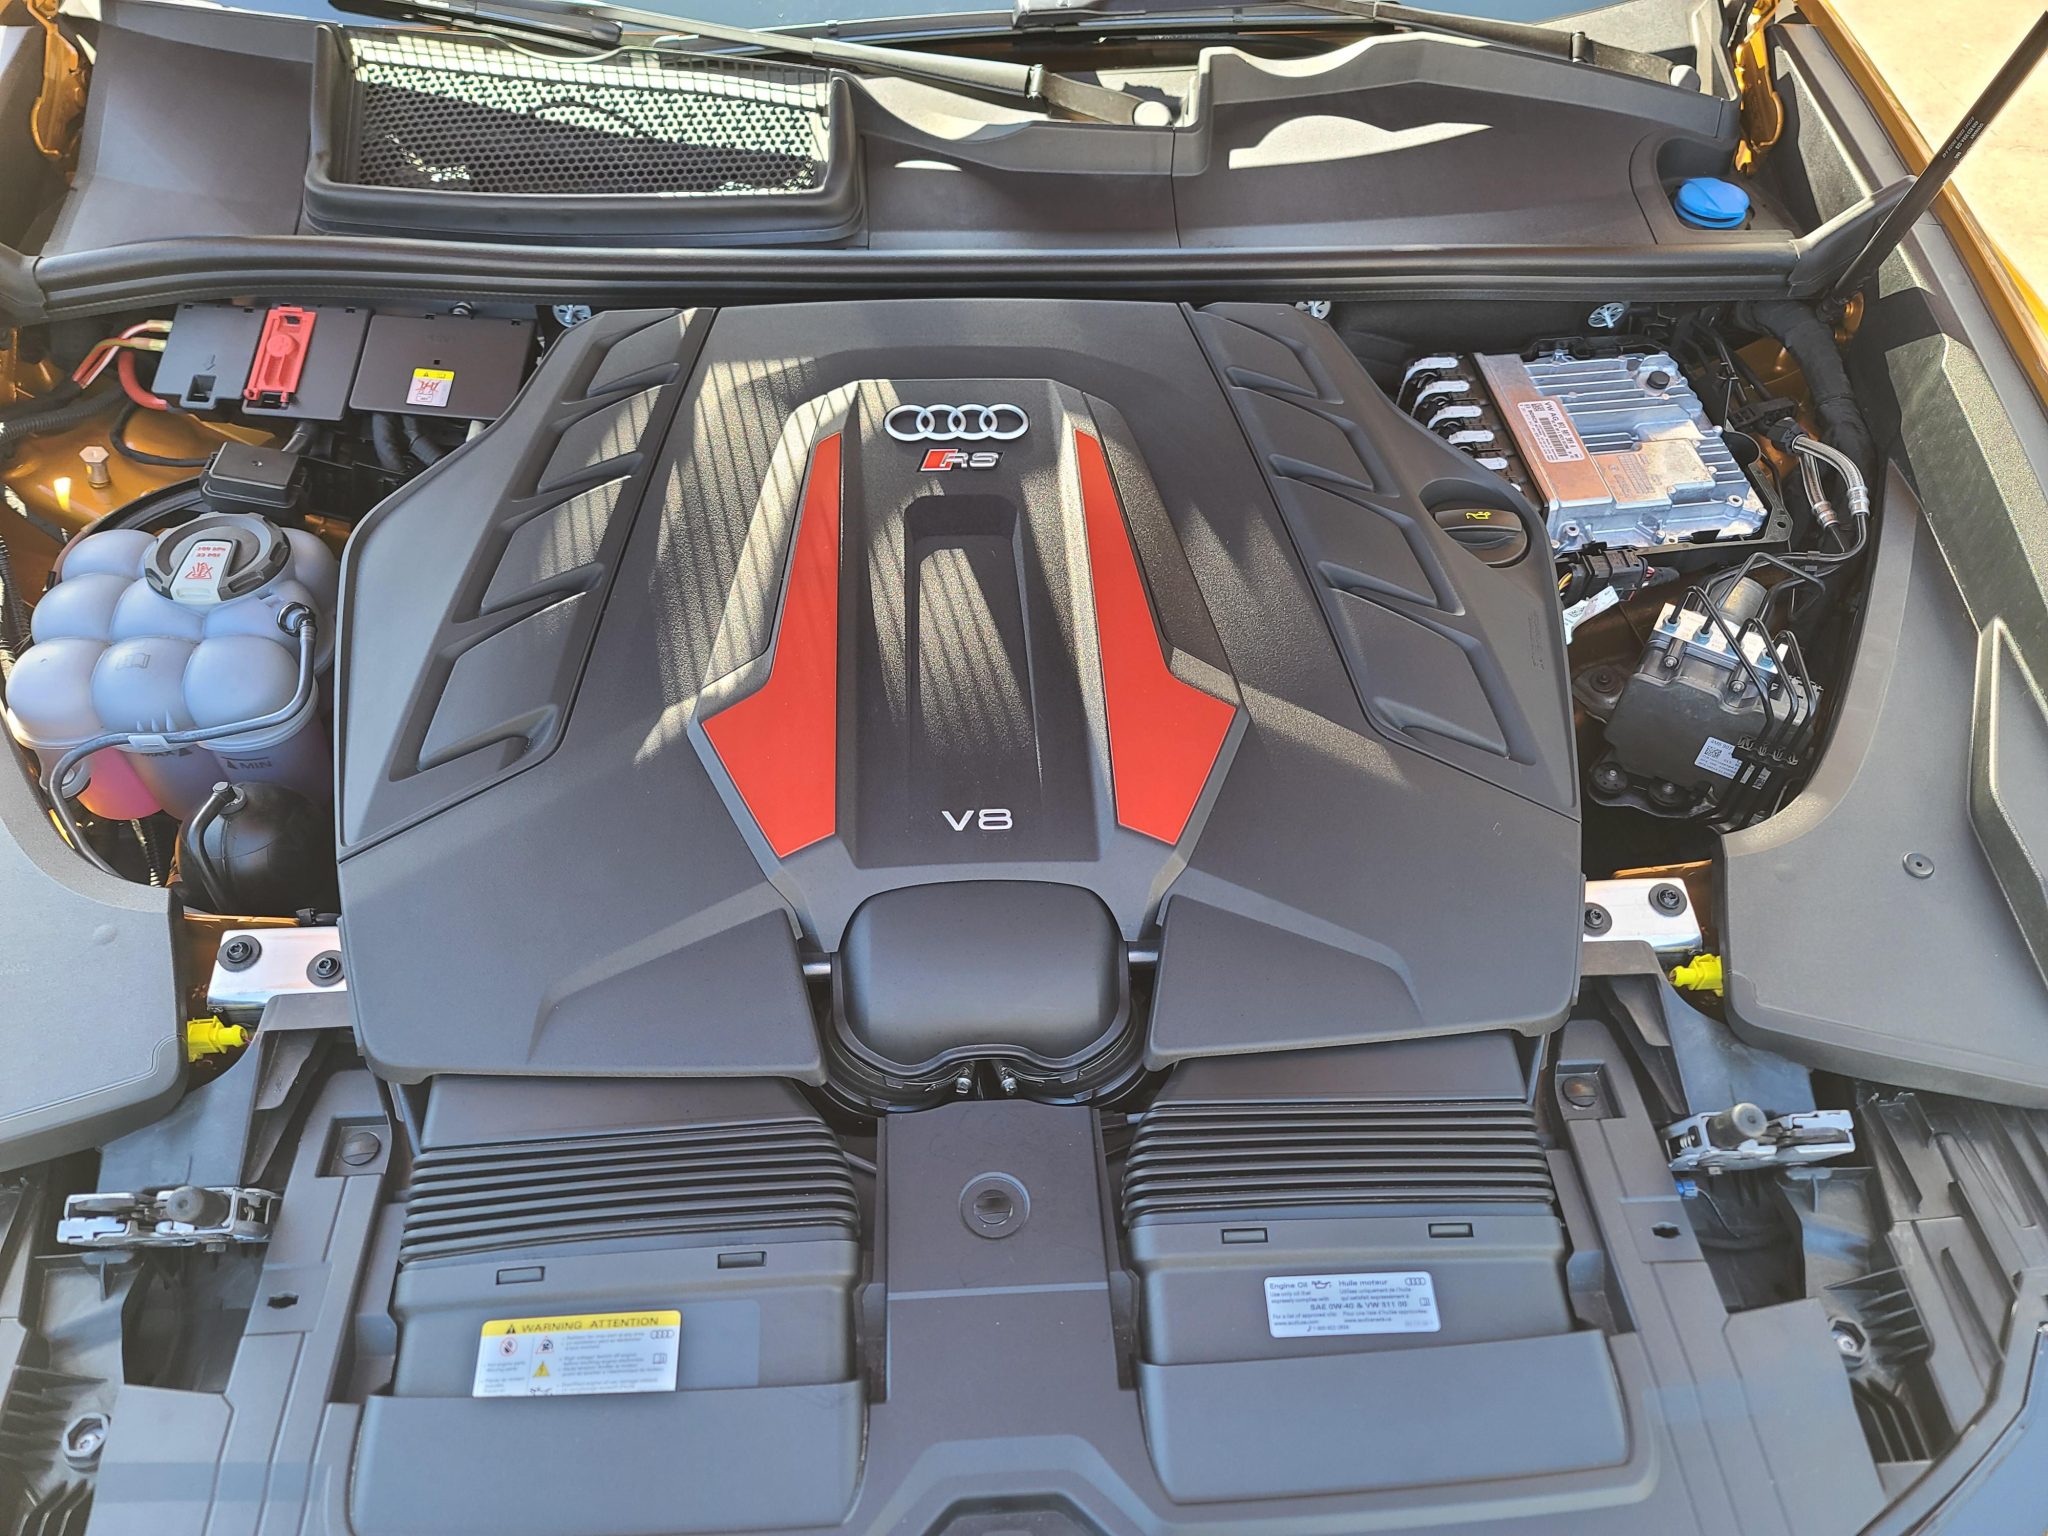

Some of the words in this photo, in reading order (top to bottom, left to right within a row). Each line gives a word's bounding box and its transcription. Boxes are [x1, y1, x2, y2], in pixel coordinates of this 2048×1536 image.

[938, 450, 1000, 469] RS
[239, 760, 273, 769] MIN
[941, 808, 1013, 831] V8
[1269, 1282, 1295, 1290] Engine
[1297, 1281, 1308, 1289] Oil
[521, 1321, 583, 1333] WARNING
[589, 1317, 660, 1330] ATTENTION
